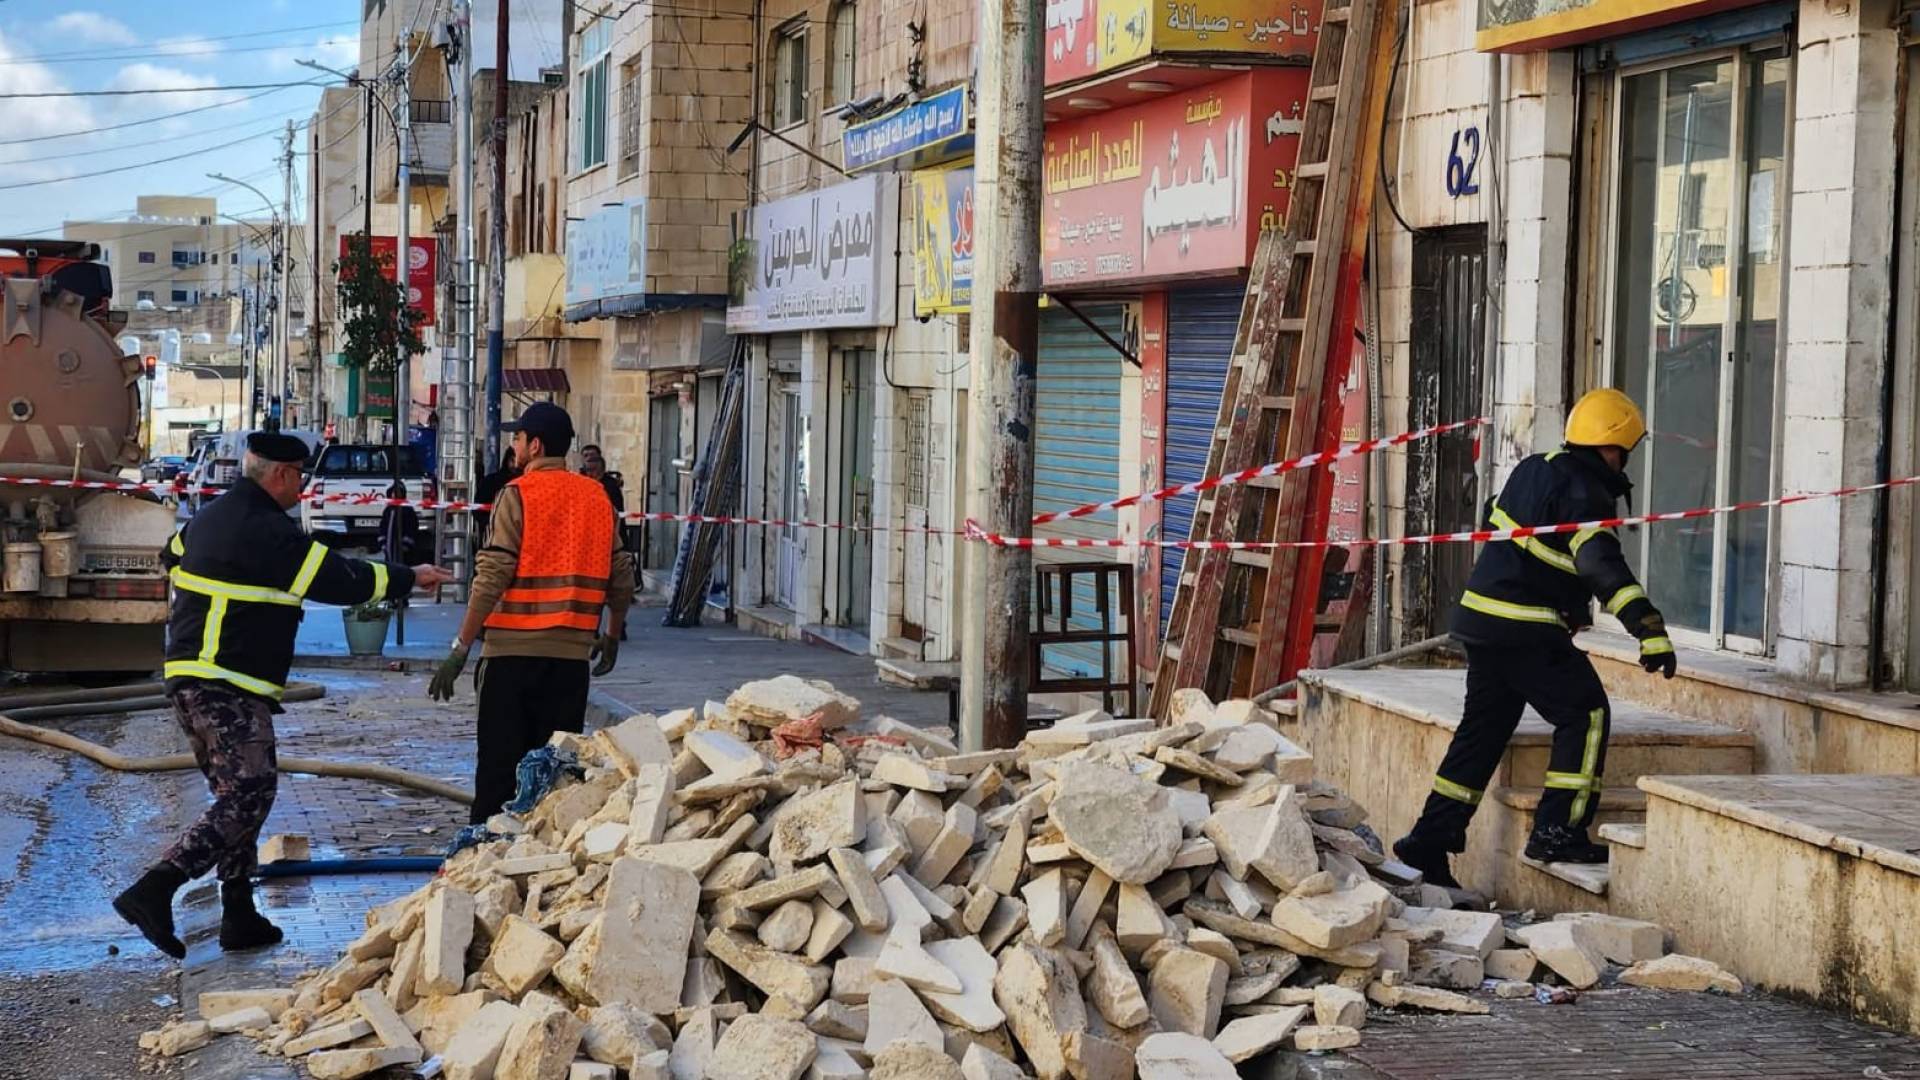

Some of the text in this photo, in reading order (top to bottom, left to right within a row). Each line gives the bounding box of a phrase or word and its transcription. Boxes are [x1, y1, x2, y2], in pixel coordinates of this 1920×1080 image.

[1167, 4, 1230, 40] صيانة
[1249, 6, 1308, 42] تأجير
[924, 103, 937, 131] الله
[937, 107, 955, 135] بسم
[1447, 126, 1479, 200] 62
[1142, 114, 1244, 269] الهيثم
[765, 198, 873, 288] معرض الحرمين
